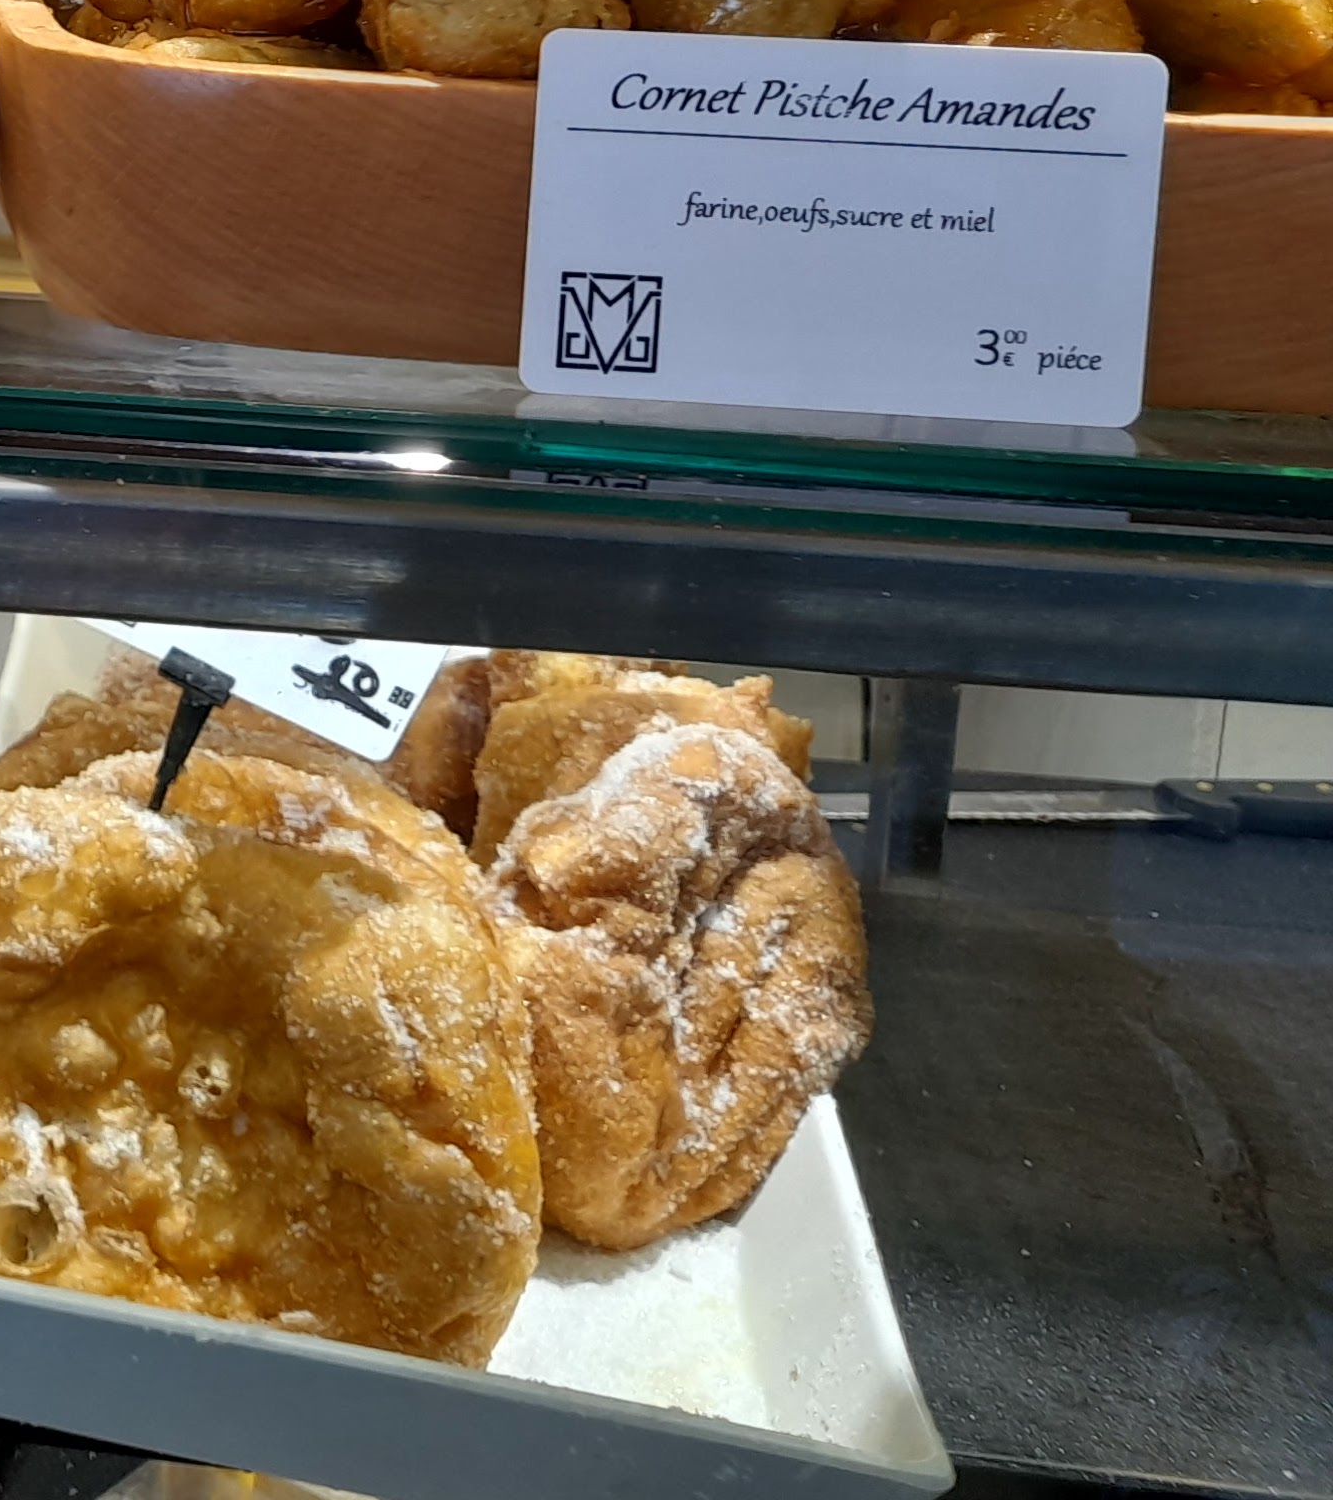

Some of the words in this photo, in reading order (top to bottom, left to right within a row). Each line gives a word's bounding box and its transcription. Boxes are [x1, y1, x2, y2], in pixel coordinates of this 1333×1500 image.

[611, 73, 747, 115] Cornet
[753, 77, 895, 123] Pistche
[896, 85, 1098, 132] Amandes
[910, 205, 934, 231] et
[940, 206, 996, 234] miel
[1036, 344, 1103, 376] piéce
